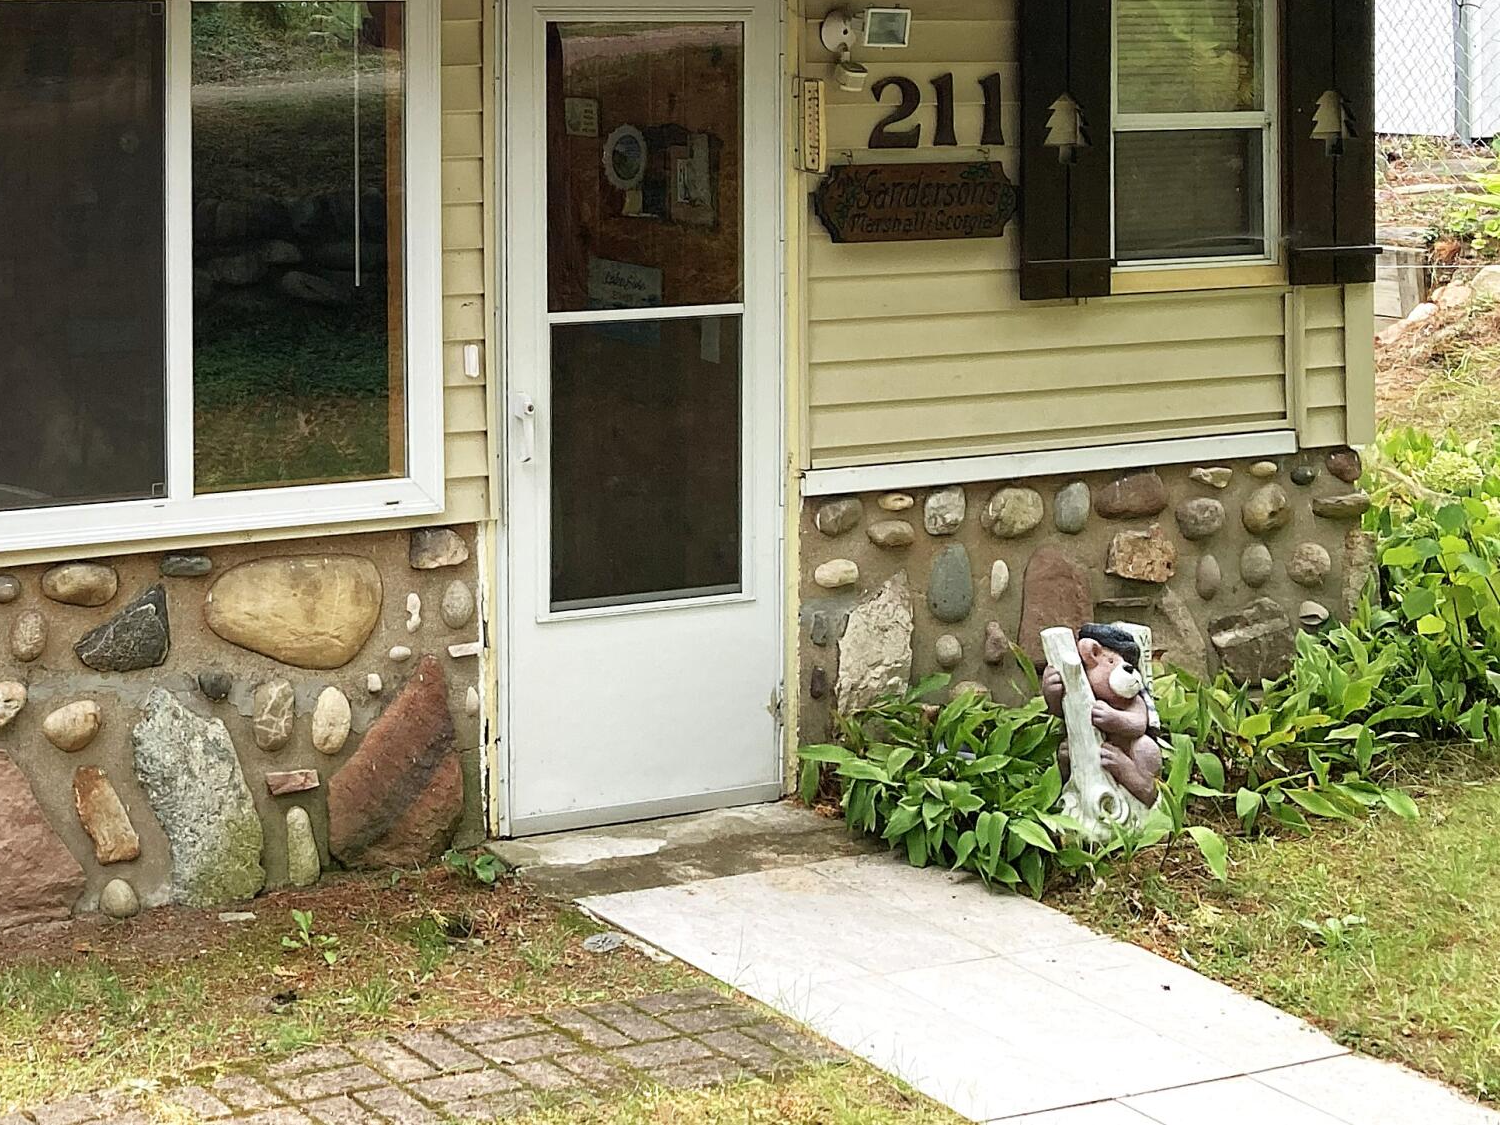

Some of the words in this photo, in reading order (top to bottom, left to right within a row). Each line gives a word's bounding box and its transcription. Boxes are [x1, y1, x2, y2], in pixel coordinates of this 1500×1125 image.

[868, 72, 1005, 149] 211
[855, 169, 999, 210] Sandersons
[849, 210, 925, 234] Marshall
[934, 209, 996, 235] Georgia
